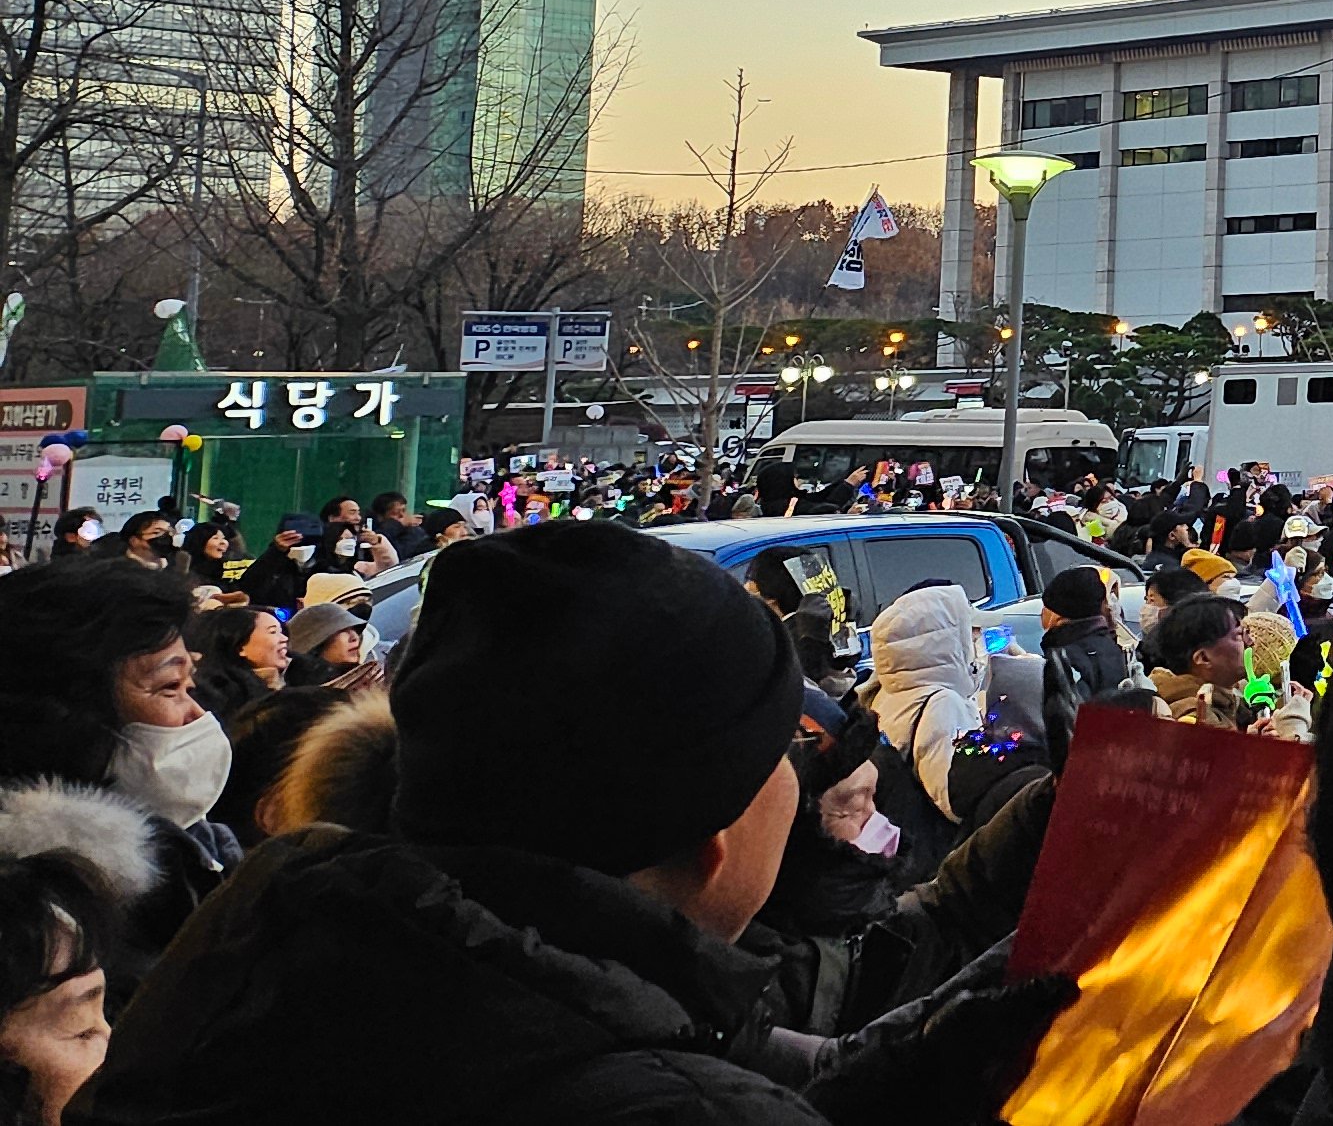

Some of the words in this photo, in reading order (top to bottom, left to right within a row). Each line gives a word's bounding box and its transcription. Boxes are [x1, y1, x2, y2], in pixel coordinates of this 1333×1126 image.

[475, 339, 490, 358] P
[563, 339, 573, 359] P
[217, 380, 402, 430] 식당가
[97, 491, 142, 506] 막국수
